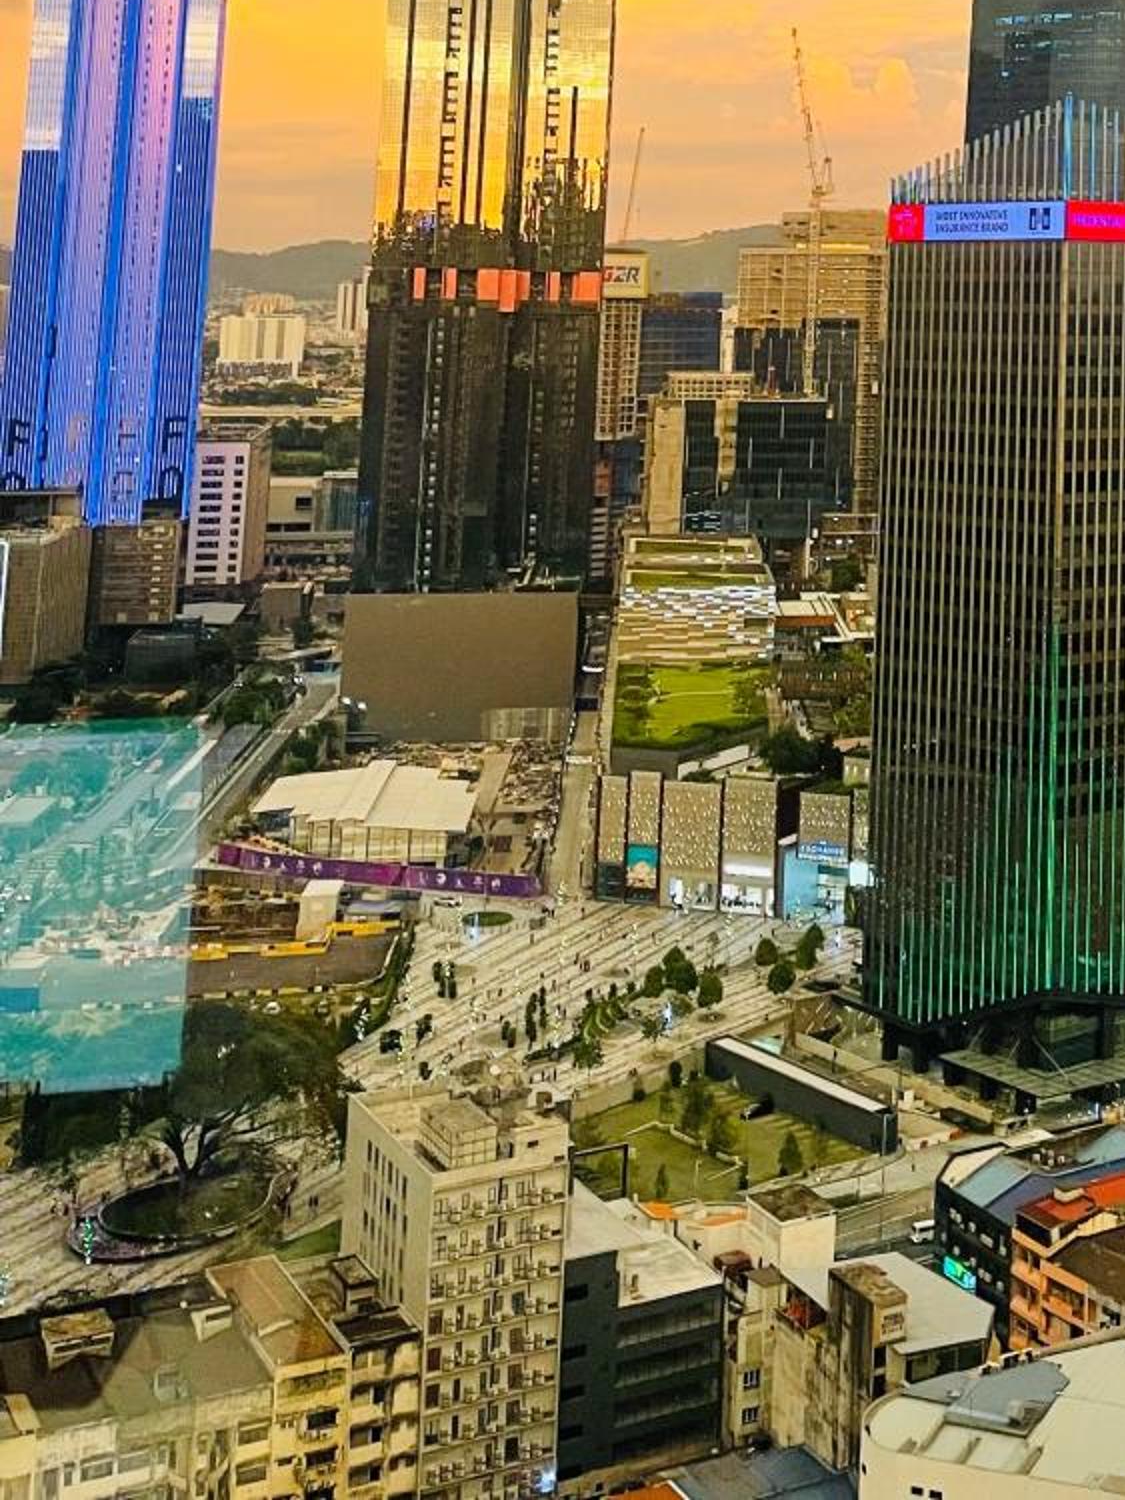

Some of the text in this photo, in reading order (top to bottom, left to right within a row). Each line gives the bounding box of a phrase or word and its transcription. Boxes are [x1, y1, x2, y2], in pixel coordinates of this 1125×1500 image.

[935, 209, 1008, 221] MOST INNOVATIVE
[935, 221, 1009, 234] INSURANCE BRAND
